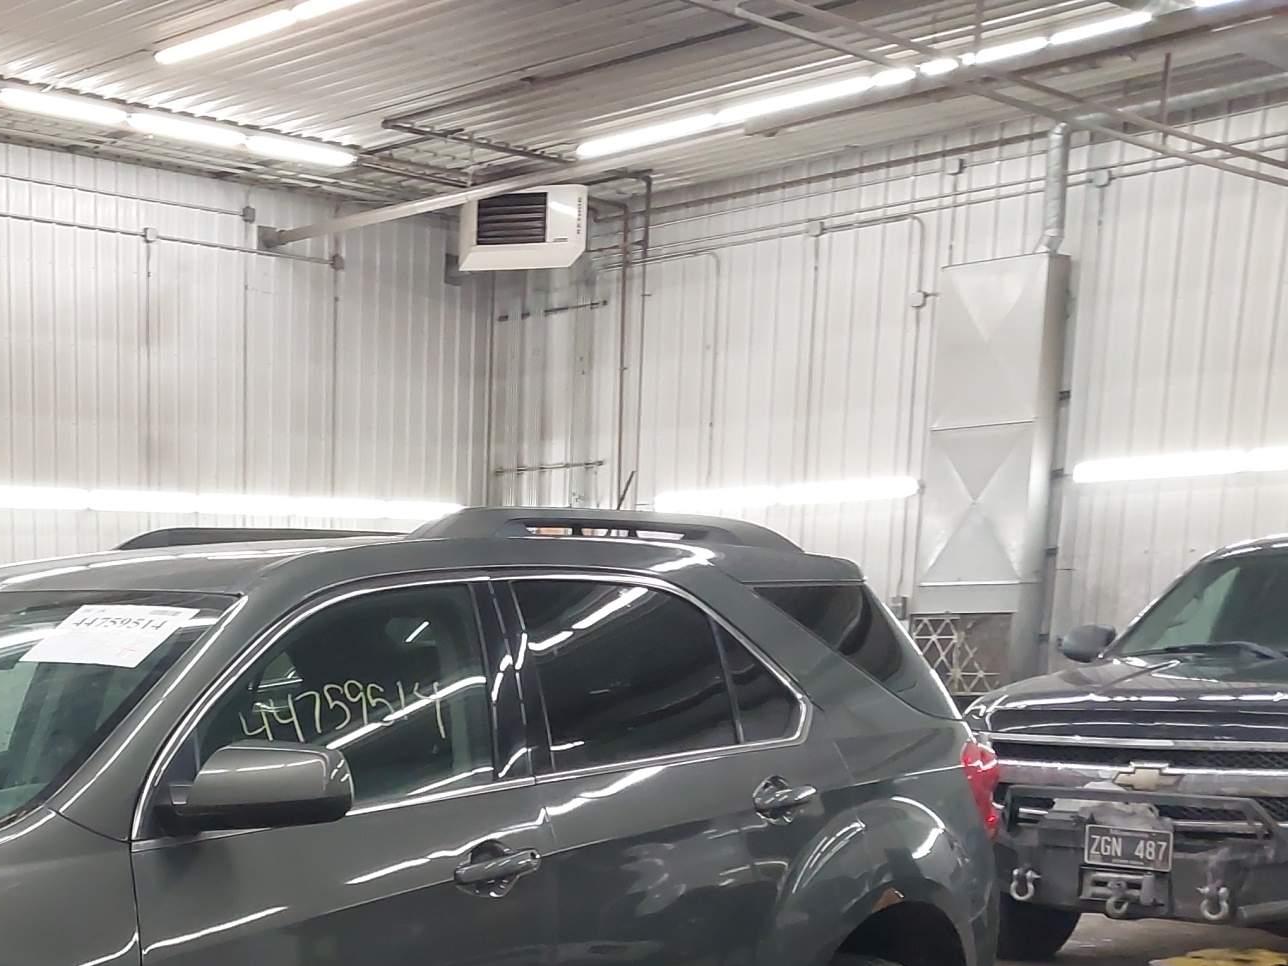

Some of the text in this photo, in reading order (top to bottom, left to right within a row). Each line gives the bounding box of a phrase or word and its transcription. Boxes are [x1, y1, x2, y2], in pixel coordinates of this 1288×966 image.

[72, 616, 168, 631] 44759514
[239, 680, 445, 743] 44759514
[1090, 835, 1167, 861] ZGN 487
